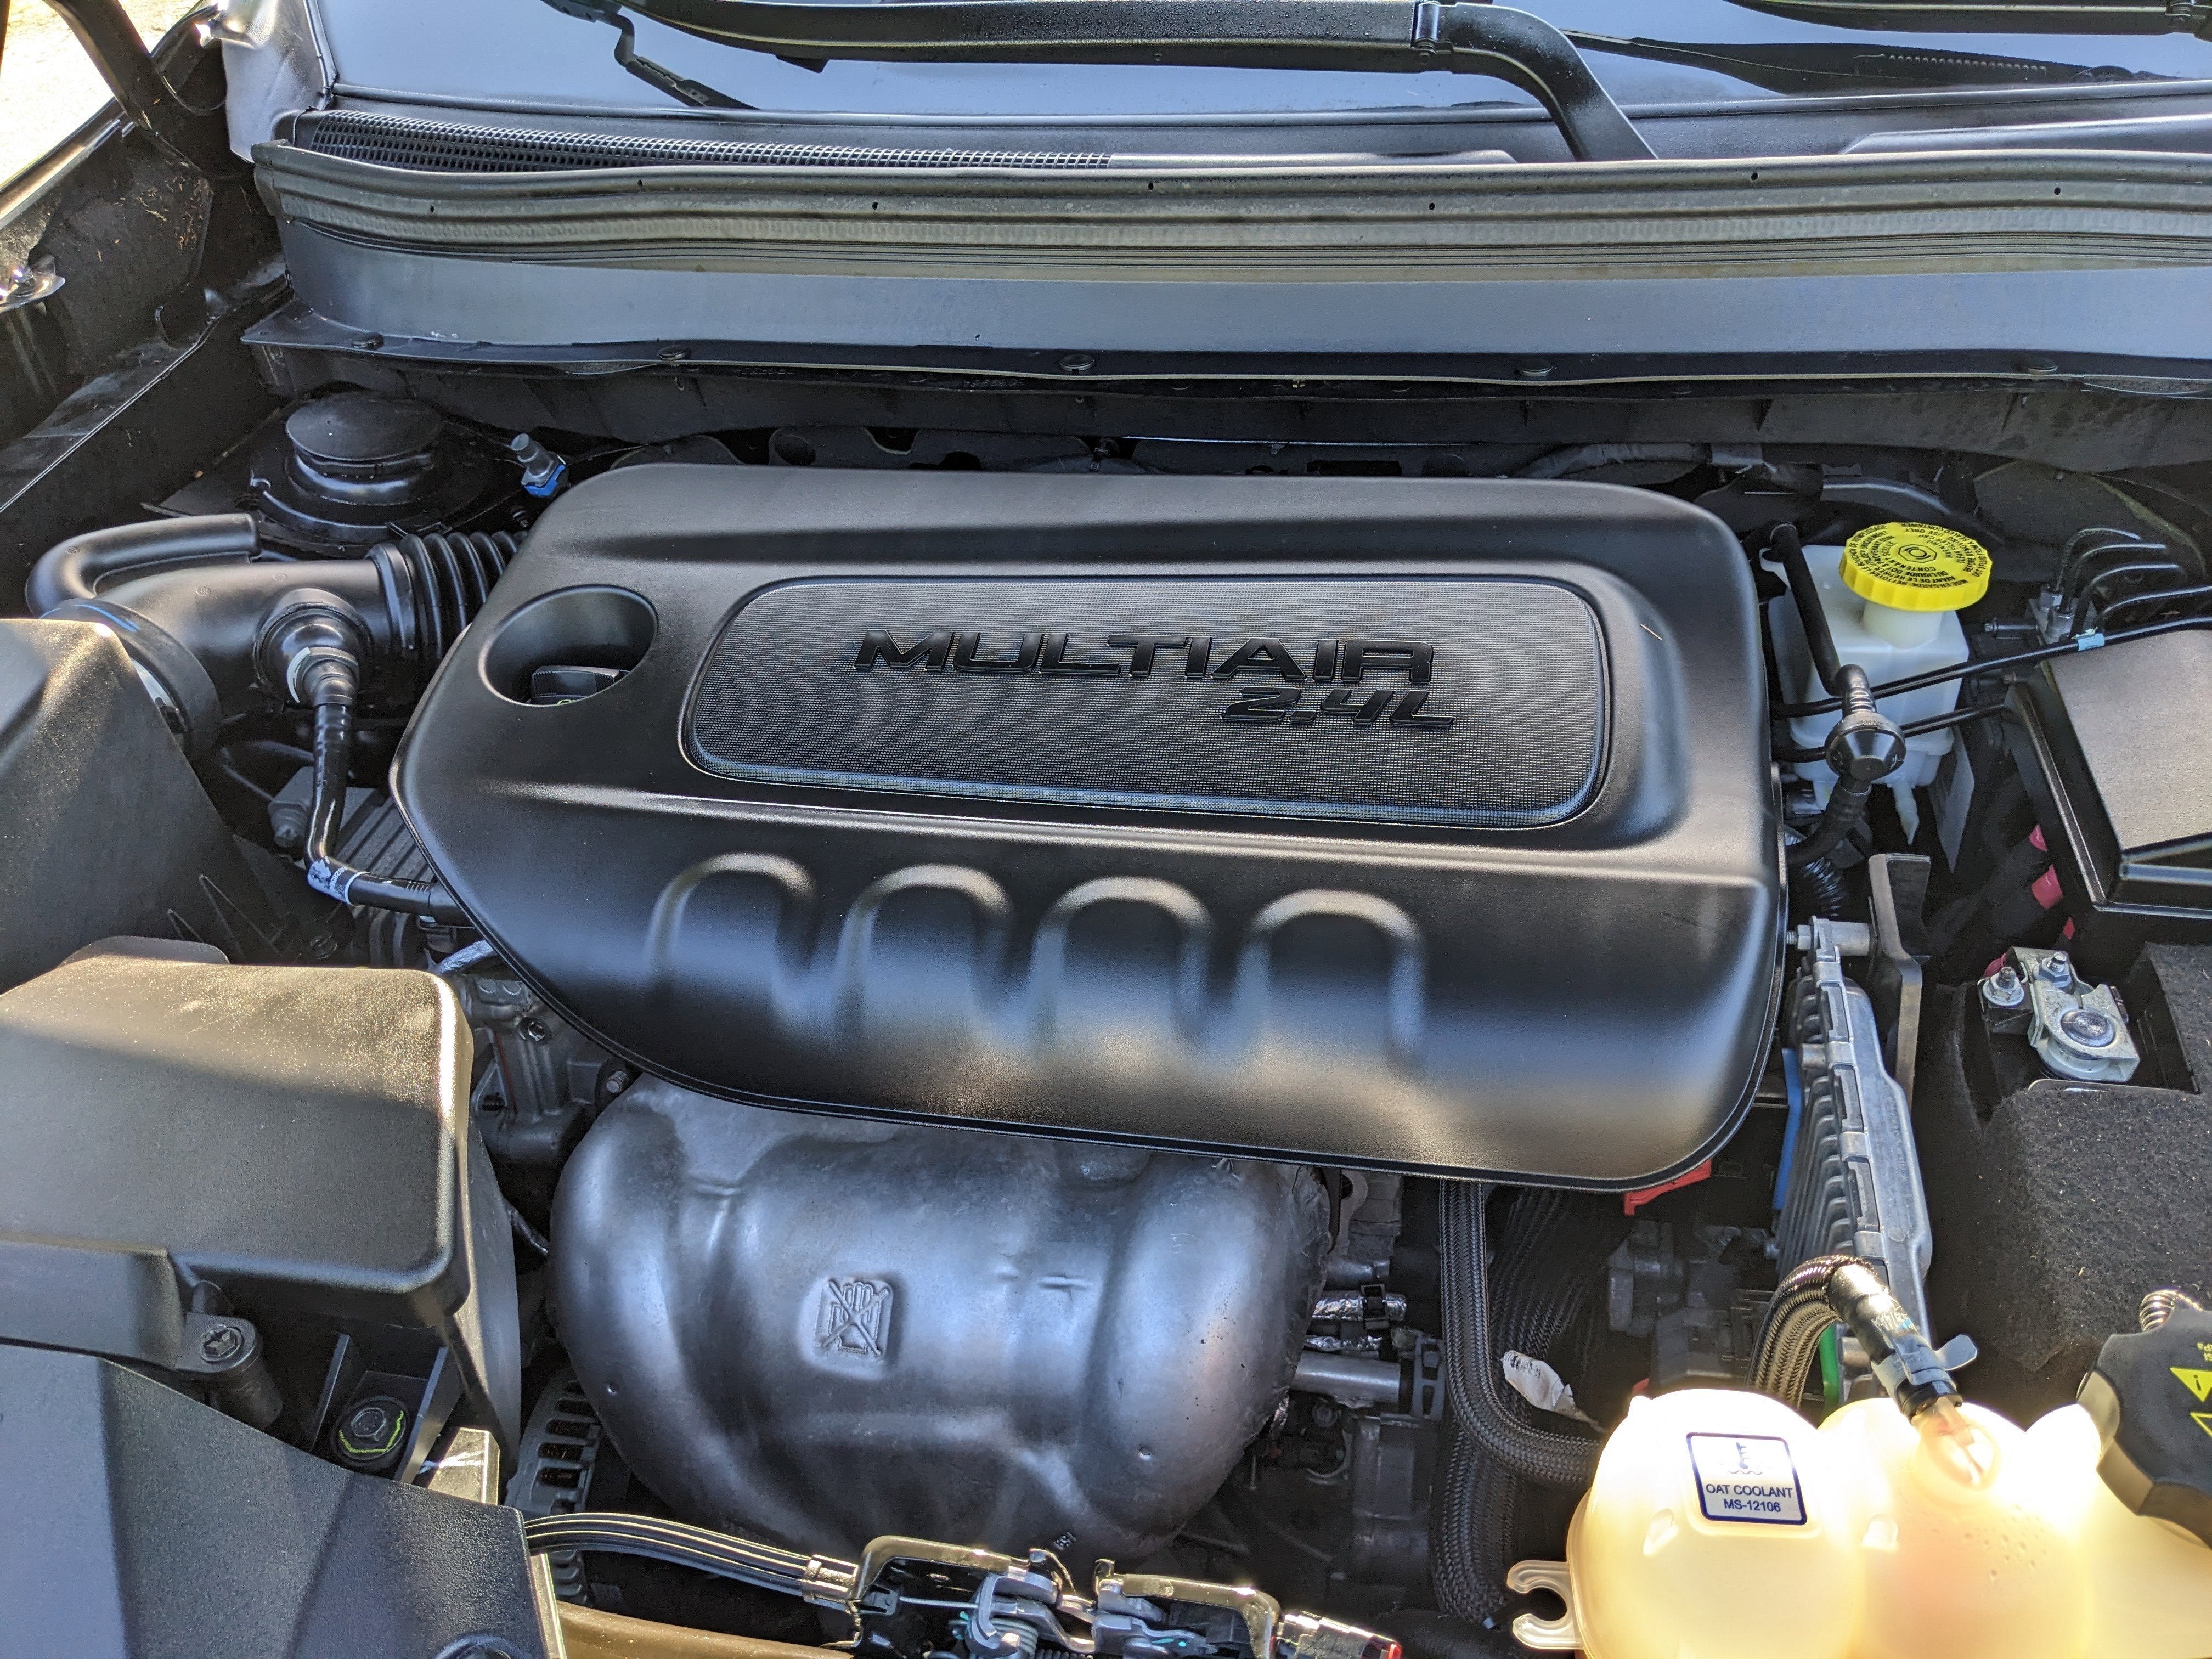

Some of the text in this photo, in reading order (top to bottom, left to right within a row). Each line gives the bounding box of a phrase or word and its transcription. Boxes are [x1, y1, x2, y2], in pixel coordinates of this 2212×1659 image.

[1944, 529, 1971, 542] SEALED
[1935, 538, 1959, 550] FILLER
[1970, 544, 1986, 555] FROM
[1953, 550, 1965, 564] CLEAN
[1978, 556, 1988, 567] FLUID
[1883, 557, 1938, 572] CONTENANT
[1884, 566, 1904, 574] DOT
[1962, 557, 1976, 573] BEFORE
[1867, 571, 1908, 585] NETTOYER
[1970, 568, 1985, 578] DOT
[853, 629, 1435, 685] MULTIAIR
[1219, 685, 1454, 727] 2.4L
[1706, 1483, 1793, 1498] OAT COOLANT
[1723, 1498, 1781, 1513] MS-12106
